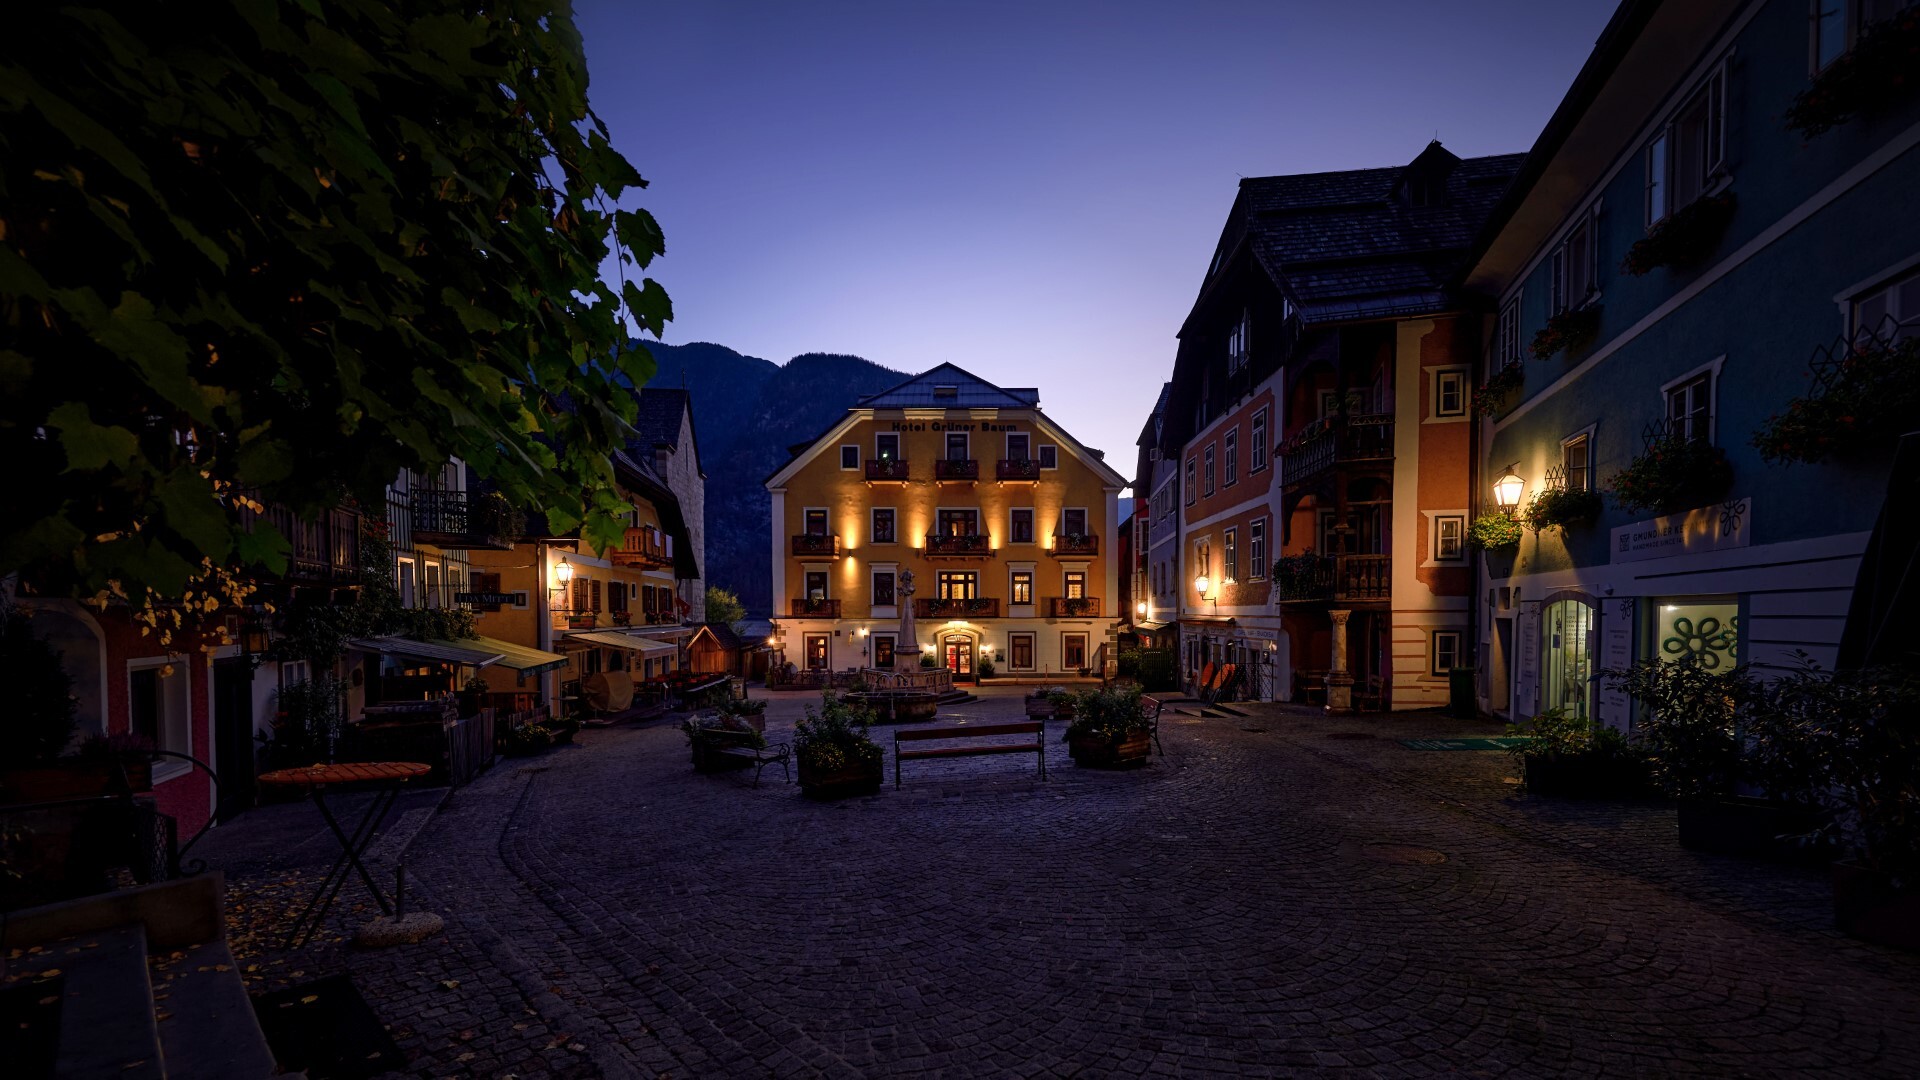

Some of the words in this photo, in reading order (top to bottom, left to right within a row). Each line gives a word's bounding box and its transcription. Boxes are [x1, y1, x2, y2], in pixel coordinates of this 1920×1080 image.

[892, 422, 925, 432] Hotel
[931, 420, 975, 432] Grüner
[982, 422, 1017, 432] Baum
[1632, 527, 1672, 542] GMUNDNER
